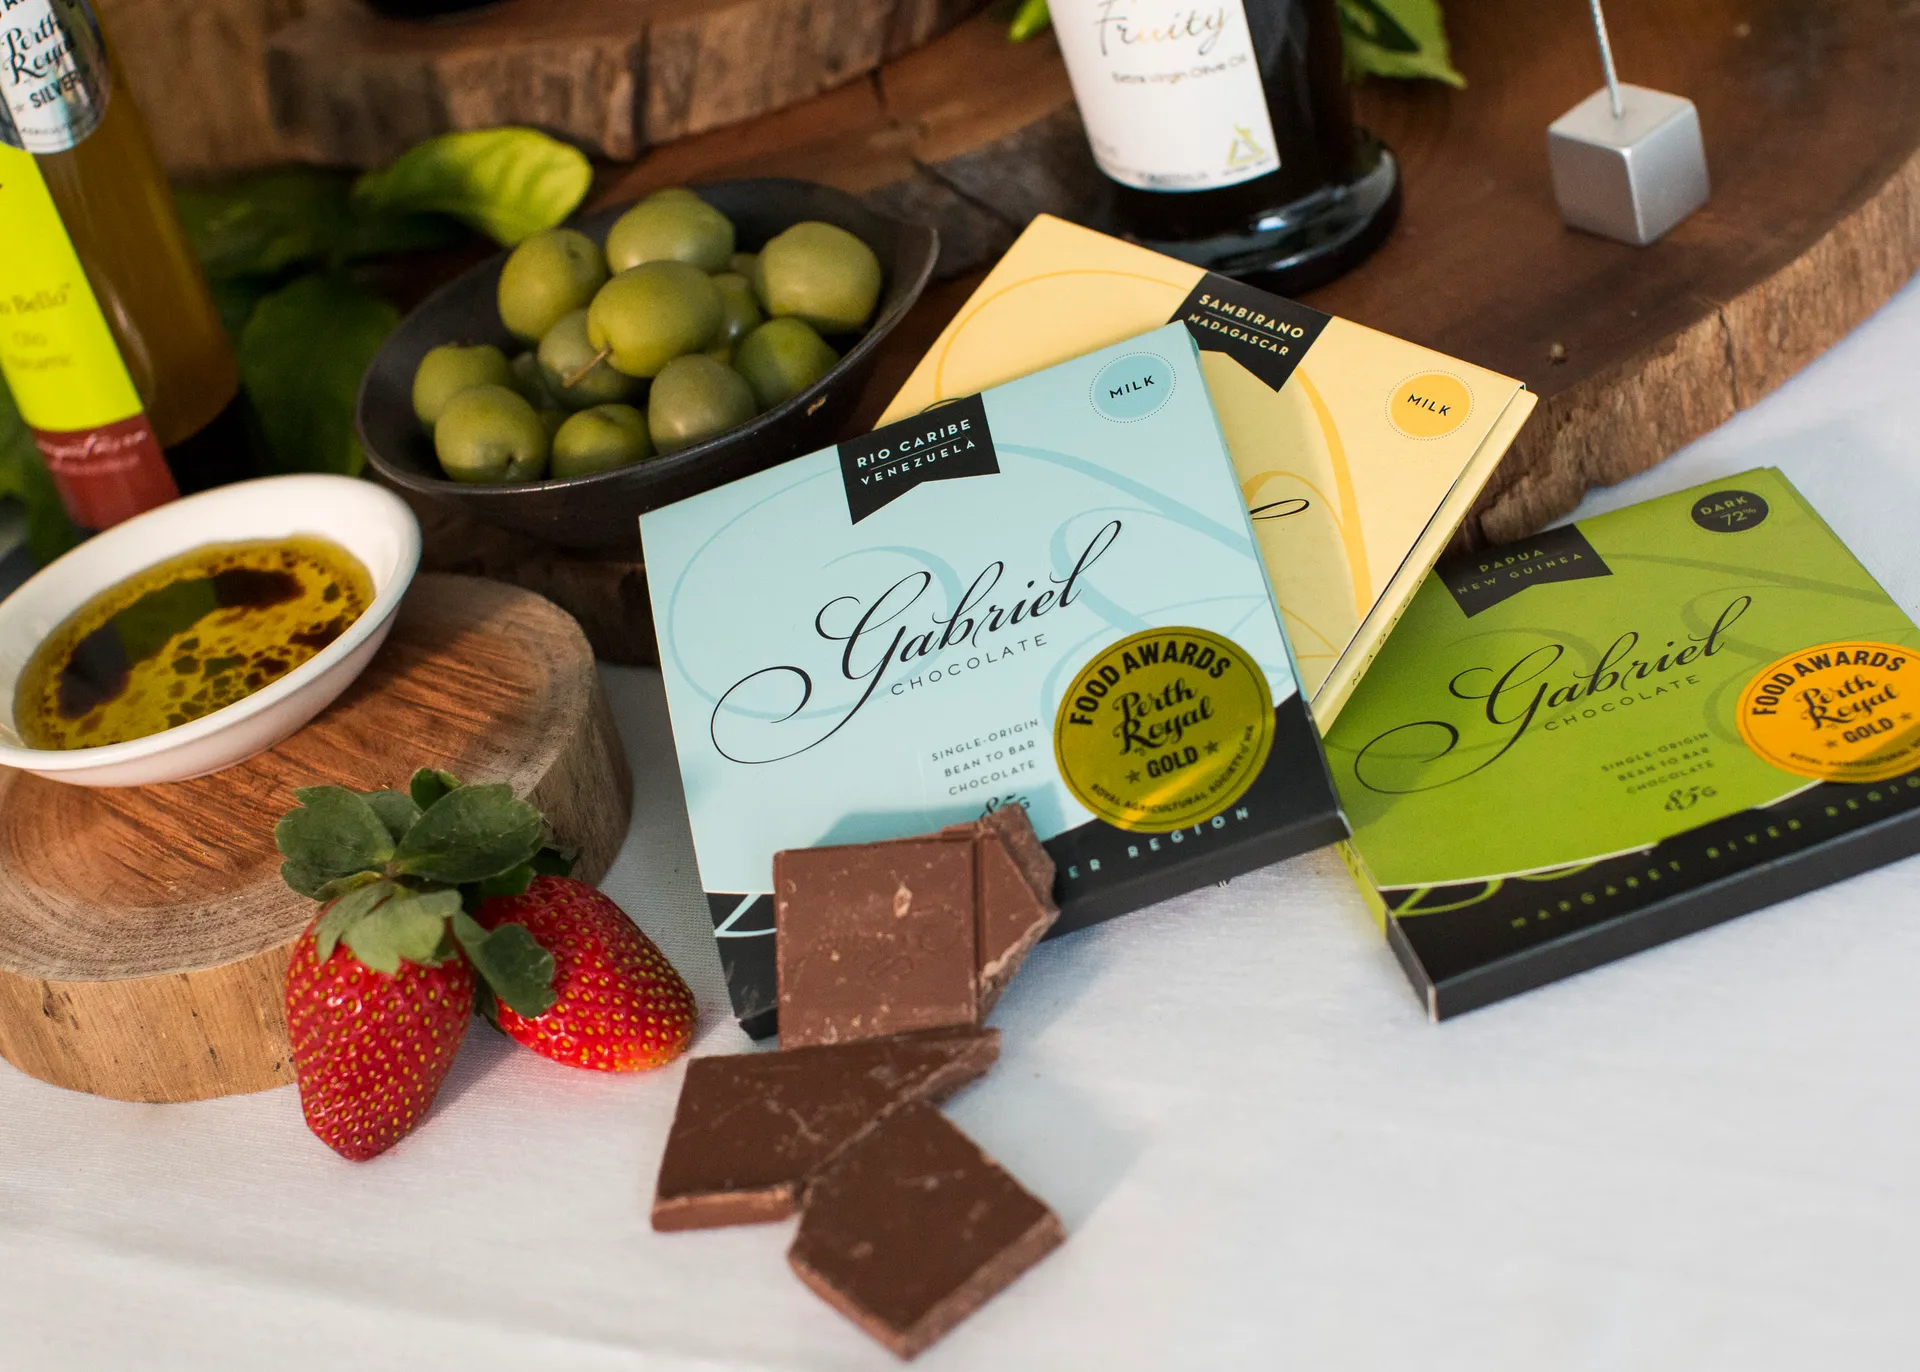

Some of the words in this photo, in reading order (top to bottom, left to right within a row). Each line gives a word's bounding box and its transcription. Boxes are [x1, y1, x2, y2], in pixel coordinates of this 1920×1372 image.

[1094, 0, 1229, 56] Fruity
[1187, 313, 1290, 356] MADAGASCAR
[1198, 293, 1305, 339] SAMBIRANO
[1109, 374, 1155, 399] MILK
[1407, 393, 1452, 417] MILK
[856, 448, 891, 468] RIO
[899, 418, 972, 453] CARIBE
[860, 440, 976, 486] VENEZUELA
[1700, 495, 1748, 516] DARK
[1456, 577, 1497, 595] NEW
[1509, 552, 1583, 579] GUINEA
[710, 519, 1122, 766] Gabriel
[890, 632, 1048, 697] CHOCOLATE
[1069, 664, 1121, 726] FOOD
[1121, 640, 1232, 680] AWARDS
[1111, 677, 1198, 724] Perth
[1354, 595, 1752, 795] Gabriel
[1544, 673, 1702, 732] CHOCOLATE
[1751, 672, 1796, 716] FOOD
[1793, 650, 1906, 678] AWARDS
[1793, 674, 1879, 712] Perth
[1112, 695, 1215, 757] Royal
[1801, 683, 1900, 731] Royal
[1843, 716, 1895, 744] GOLD
[931, 718, 1040, 762] SINGLE-ORIGIN
[944, 758, 981, 778] BEAN
[985, 750, 1004, 764] TO
[1008, 739, 1036, 756] BAR
[1146, 745, 1199, 779] GOLD
[1600, 732, 1709, 773] SINGLE-ORIGIN
[948, 759, 1036, 796] CHOCOLATE
[1616, 764, 1656, 782] BEAN
[1660, 756, 1679, 768] TO
[1682, 746, 1710, 761] BAR
[1625, 759, 1714, 795] CHOCOLATE
[1128, 806, 1249, 859] REGION
[1511, 861, 1681, 929] MARGARET
[1705, 818, 1801, 859] RIVER
[1824, 776, 1920, 818] REGIO
